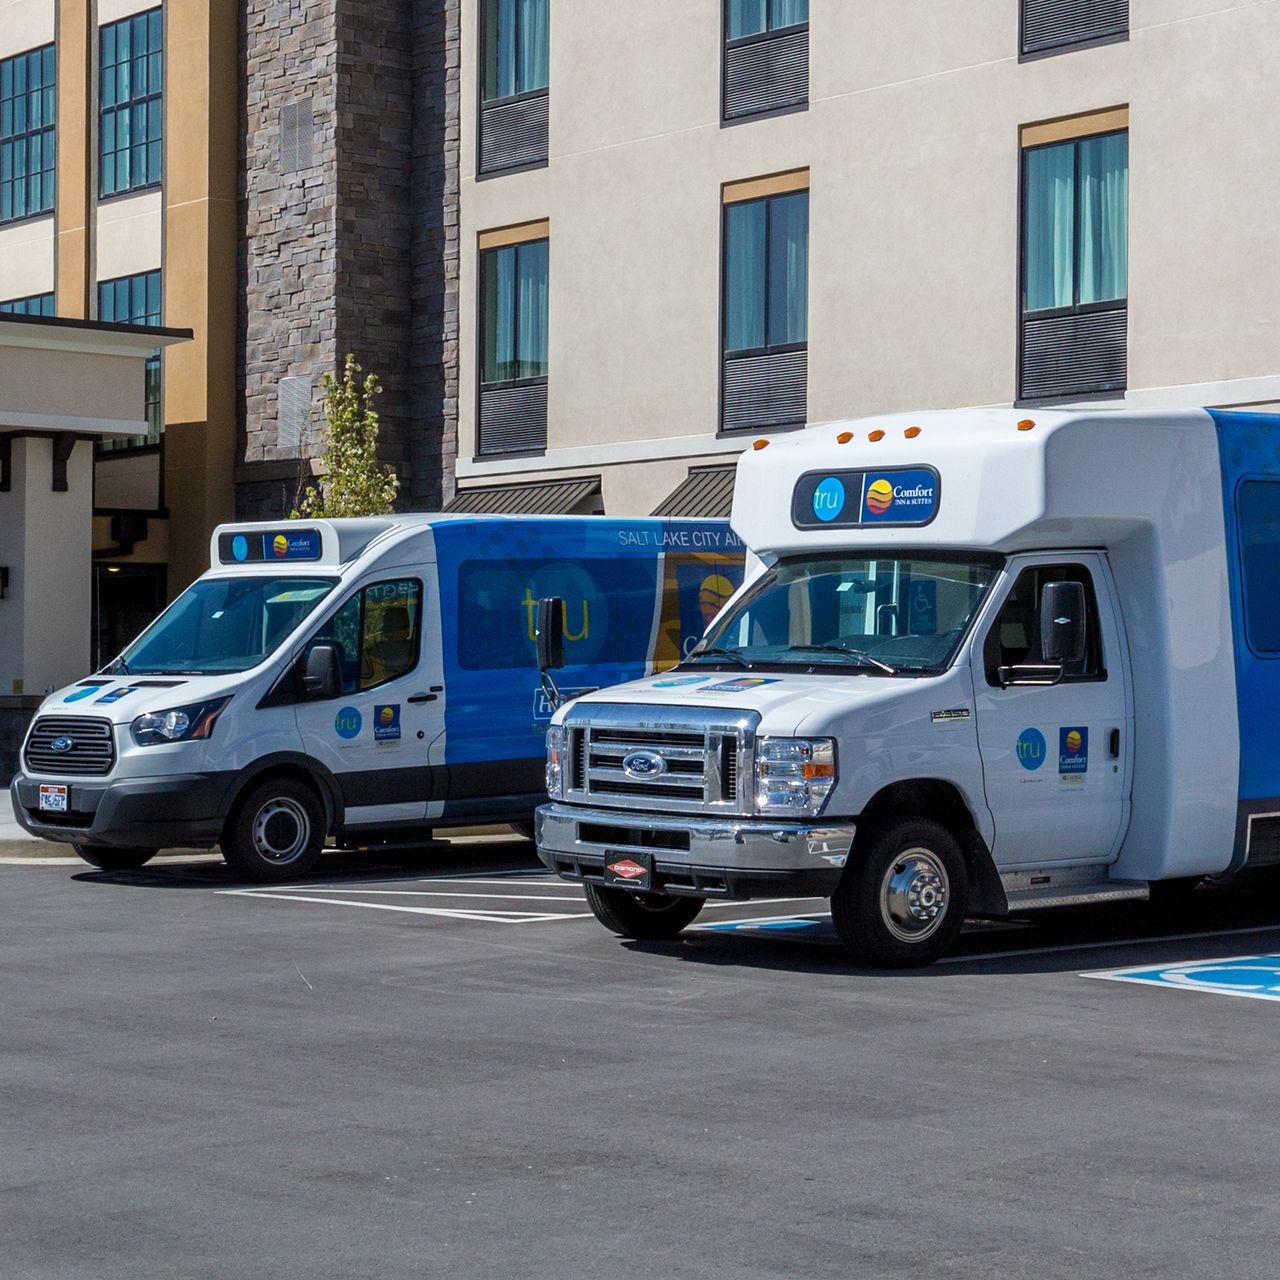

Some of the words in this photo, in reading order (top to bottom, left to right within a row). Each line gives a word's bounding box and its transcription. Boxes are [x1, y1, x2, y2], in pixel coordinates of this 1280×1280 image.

[813, 488, 838, 510] tru
[893, 484, 933, 498] Comfort
[618, 530, 649, 546] SALT
[653, 531, 690, 547] LAKE
[692, 531, 721, 547] CITY
[522, 588, 589, 641] tu
[1017, 738, 1041, 760] tru
[1060, 753, 1088, 765] Comfort
